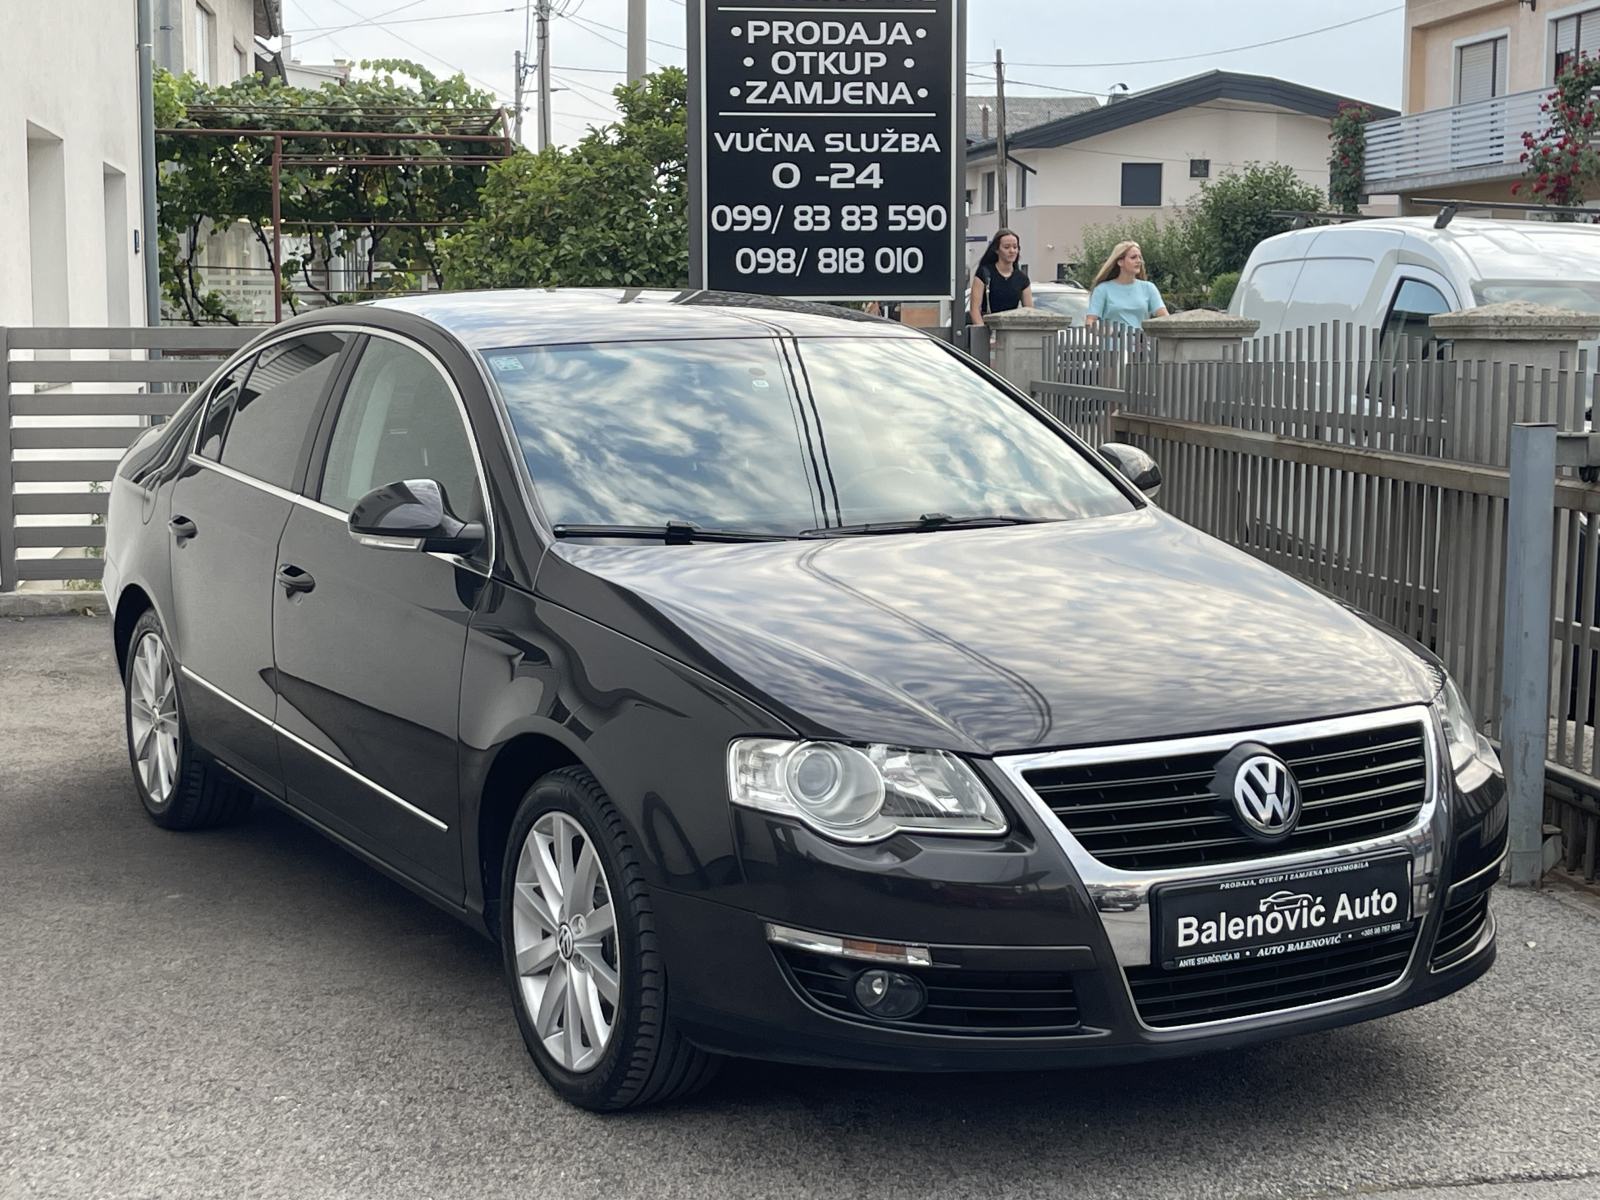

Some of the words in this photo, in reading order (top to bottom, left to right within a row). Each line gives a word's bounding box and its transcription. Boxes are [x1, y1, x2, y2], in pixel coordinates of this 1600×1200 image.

[747, 20, 913, 46] PRODAJA
[771, 51, 887, 75] OTKUP
[746, 80, 915, 105] ZAMJENA
[714, 127, 815, 153] VUČNA
[824, 128, 941, 153] SLUŽBA
[711, 204, 784, 235] 099/
[793, 204, 831, 232] 83
[841, 204, 878, 232] 83
[888, 204, 947, 232] 590
[735, 247, 808, 277] 098/
[817, 247, 865, 275] 818
[875, 247, 924, 274] 010
[1220, 879, 1257, 890] PRODAJA,
[1258, 876, 1284, 885] OTKUP
[1324, 861, 1370, 874] AUTOMOBILA
[1177, 896, 1326, 948] Balenović
[1332, 888, 1398, 924] Auto
[1256, 945, 1285, 957] AUTO
[1287, 932, 1342, 952] BALENOVIĆ
[1179, 958, 1196, 968] ANTE
